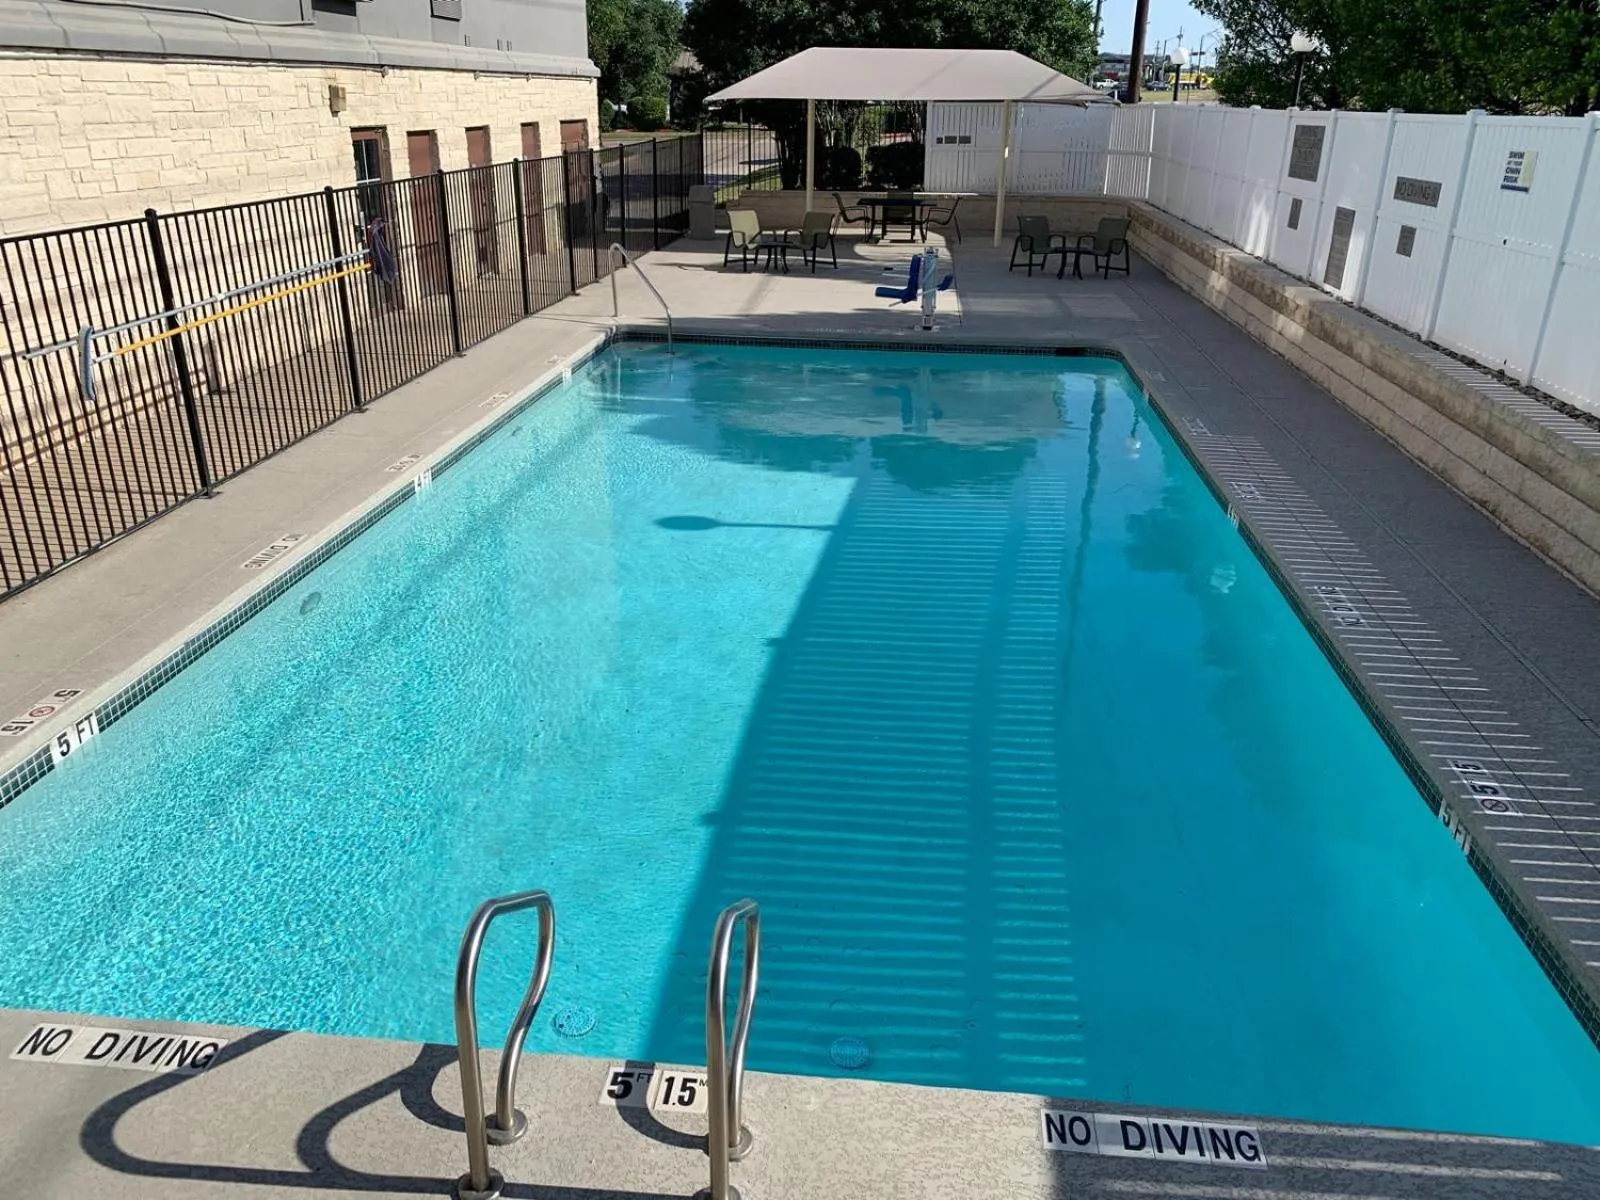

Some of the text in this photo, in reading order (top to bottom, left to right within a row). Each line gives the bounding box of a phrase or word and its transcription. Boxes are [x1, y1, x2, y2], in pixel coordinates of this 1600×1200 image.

[57, 712, 95, 757] 5 FT
[17, 1027, 220, 1069] NO DIVING
[607, 1071, 635, 1099] 5
[1045, 1113, 1262, 1162] NO DIVING
